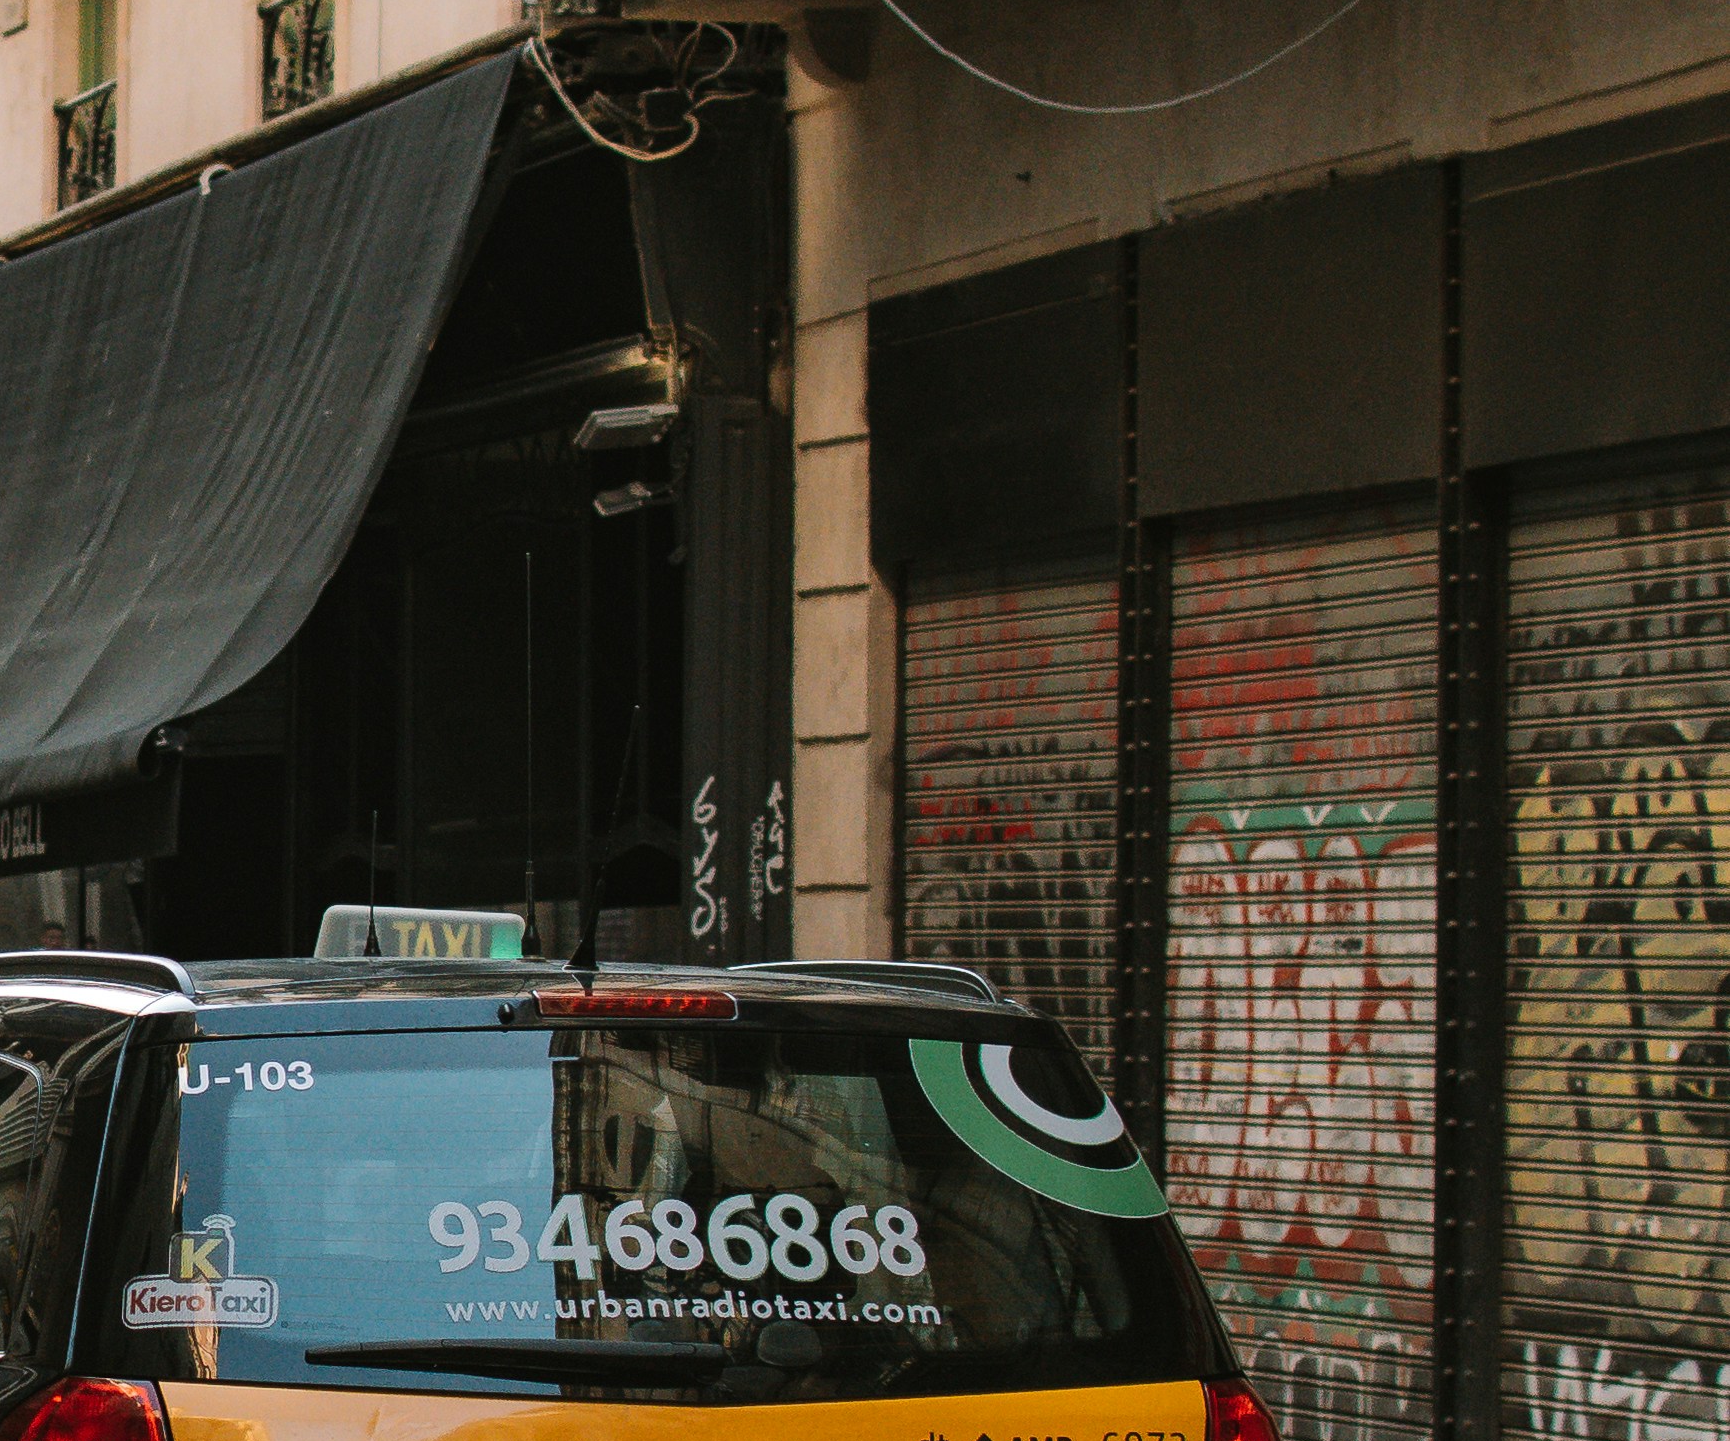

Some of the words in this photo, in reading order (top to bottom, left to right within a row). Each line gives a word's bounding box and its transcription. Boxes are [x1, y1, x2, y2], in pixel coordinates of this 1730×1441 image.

[13, 805, 46, 858] BELL
[391, 920, 482, 958] TAXI
[178, 1060, 315, 1095] U-103
[427, 1193, 927, 1283] 934686868
[179, 1238, 223, 1279] K
[129, 1286, 267, 1316] KieroTaxi
[444, 1289, 943, 1326] www.urbanradiotaxi.com
